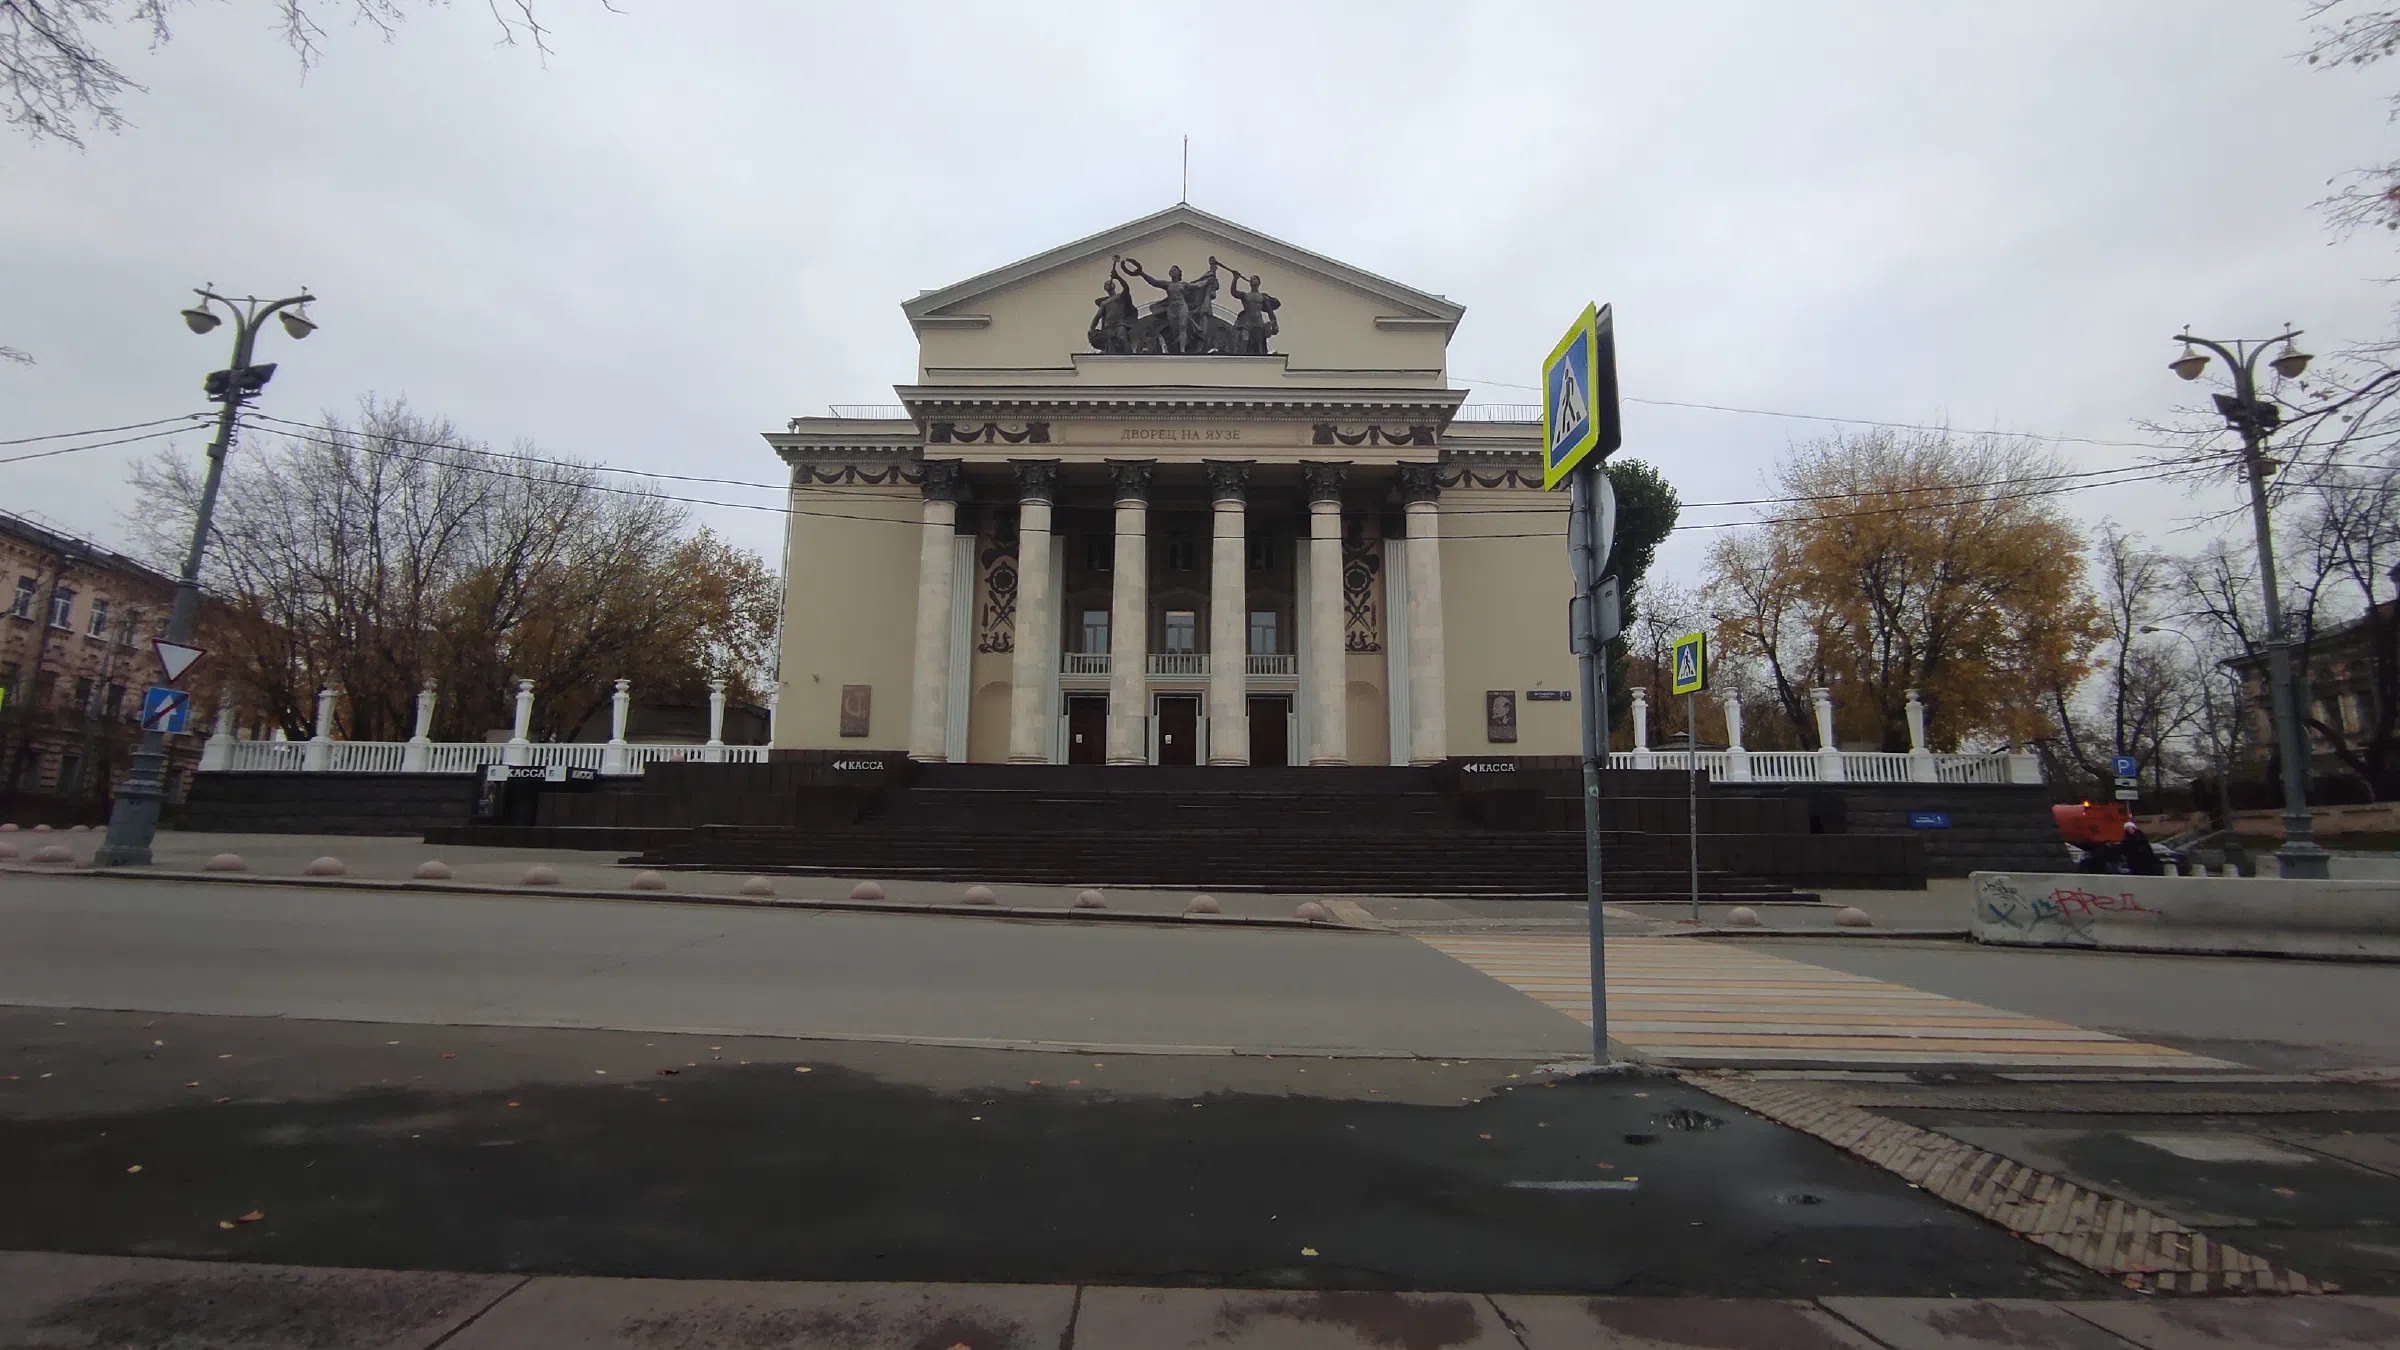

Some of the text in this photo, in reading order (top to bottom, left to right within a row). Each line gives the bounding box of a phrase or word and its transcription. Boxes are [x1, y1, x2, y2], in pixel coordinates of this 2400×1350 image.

[1121, 429, 1241, 441] ДВОРЕЦ НА ЯУЗЕ
[848, 761, 884, 770] КАССА
[1478, 763, 1516, 772] КАССА
[2117, 759, 2130, 774] P
